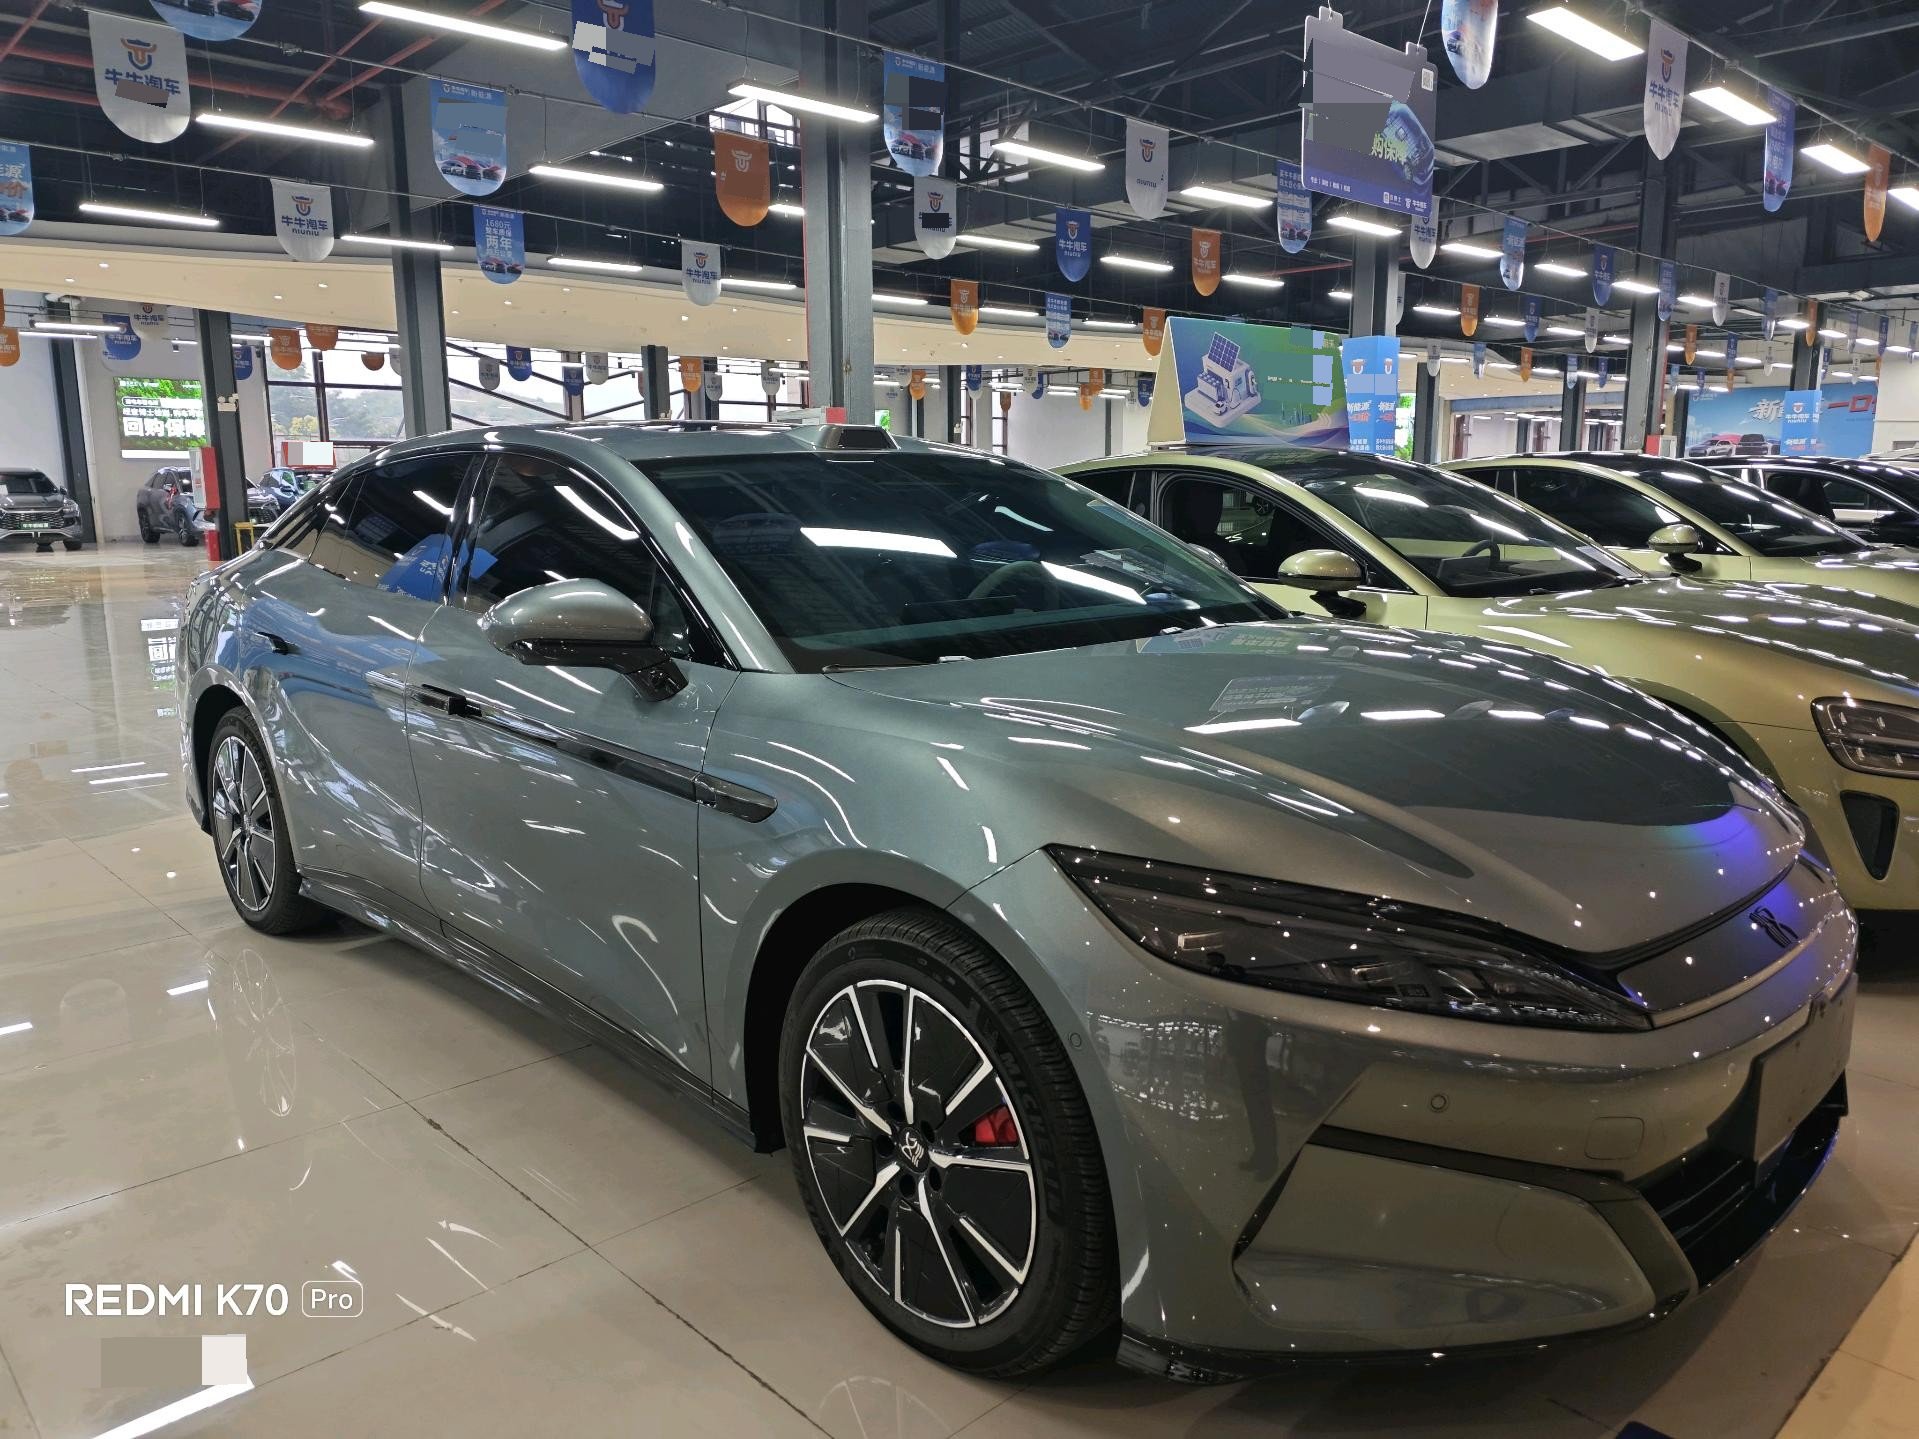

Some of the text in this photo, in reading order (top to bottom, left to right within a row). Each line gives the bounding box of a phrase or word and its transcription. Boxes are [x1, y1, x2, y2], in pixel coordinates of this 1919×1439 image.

[281, 215, 329, 231] 牛牛淘车
[485, 235, 512, 251] 两年
[1827, 395, 1877, 416] 一口
